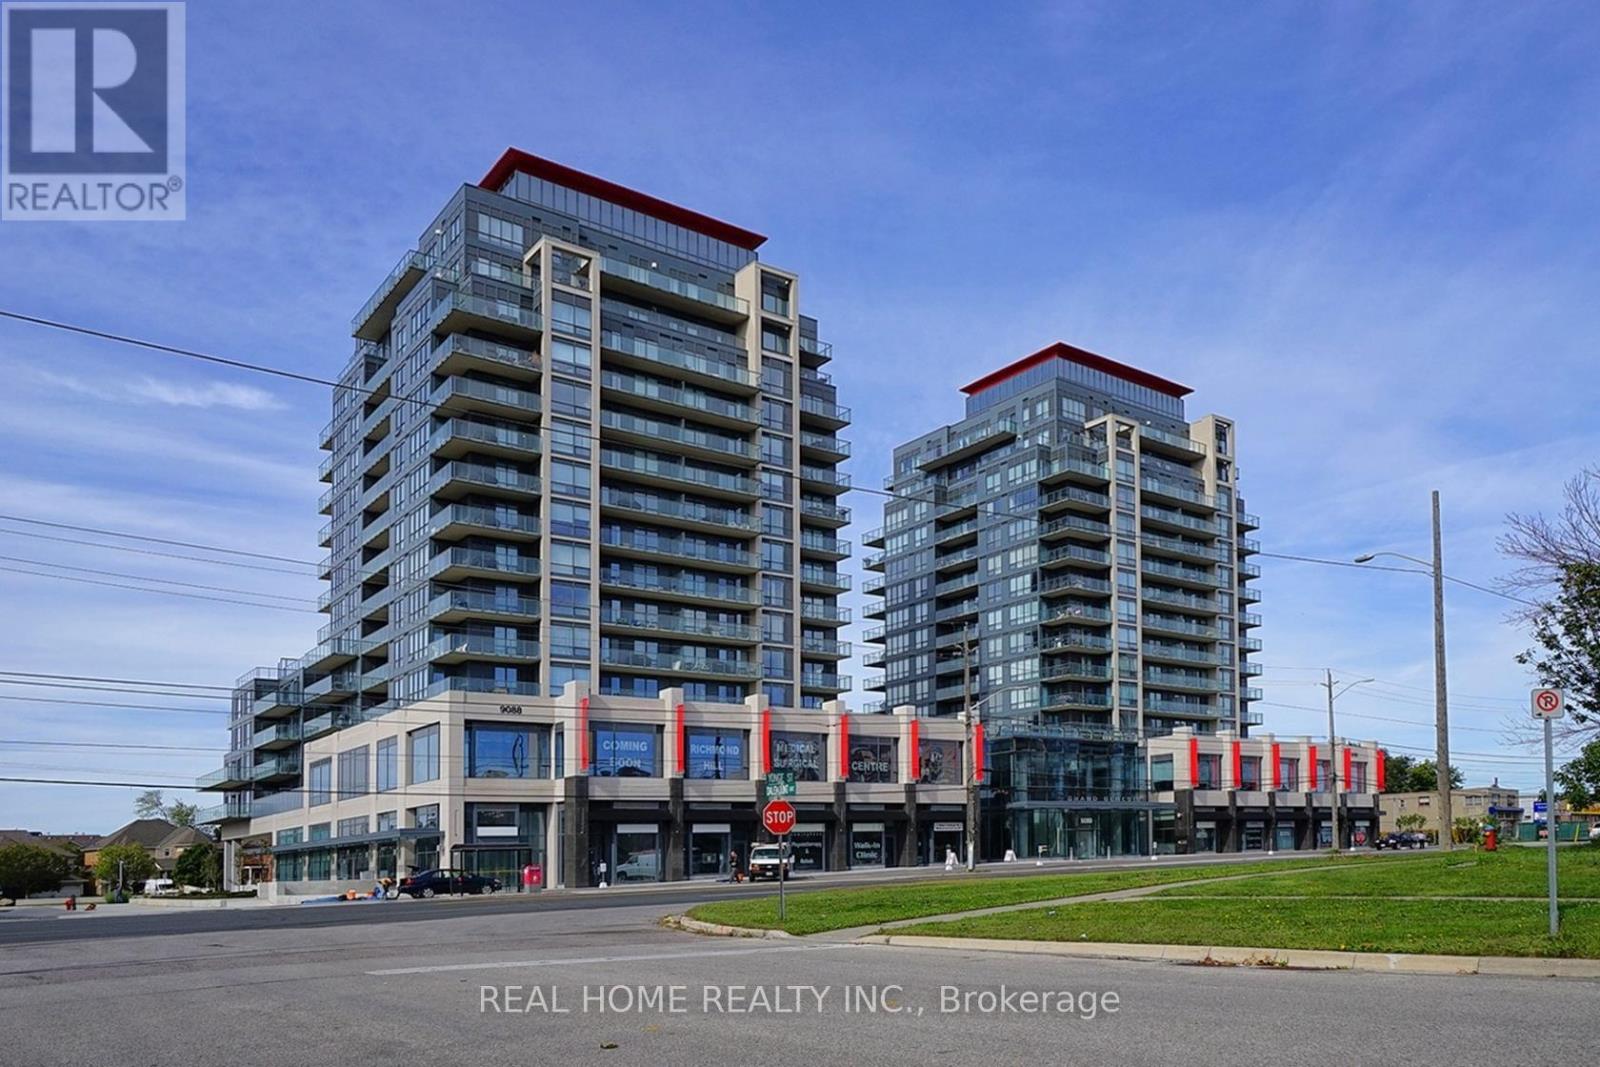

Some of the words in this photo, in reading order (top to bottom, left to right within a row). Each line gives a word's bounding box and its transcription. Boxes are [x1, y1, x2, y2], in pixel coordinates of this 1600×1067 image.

[602, 740, 648, 752] COMING
[690, 743, 740, 756] RICHMOND
[851, 761, 889, 772] CENTRE
[766, 810, 794, 824] STOP
[855, 851, 878, 859] Clinic
